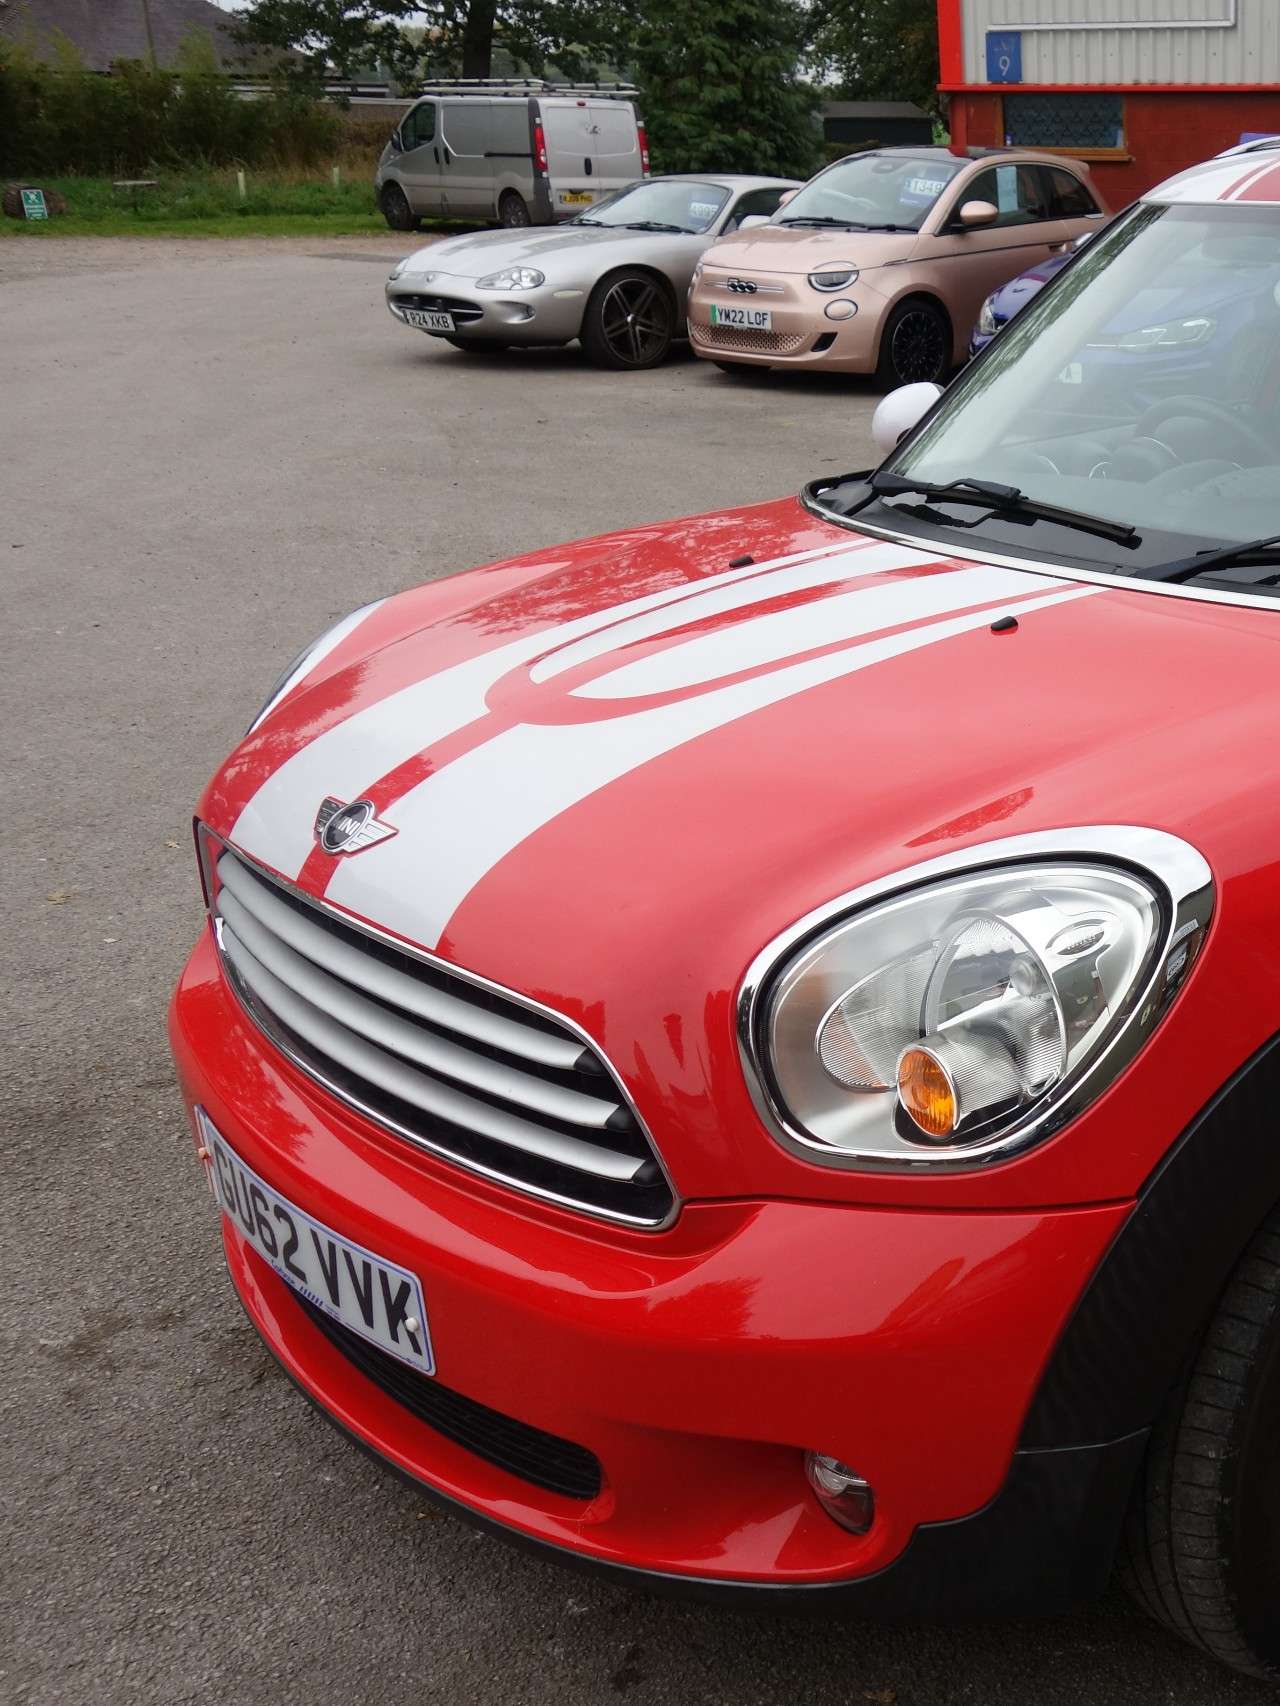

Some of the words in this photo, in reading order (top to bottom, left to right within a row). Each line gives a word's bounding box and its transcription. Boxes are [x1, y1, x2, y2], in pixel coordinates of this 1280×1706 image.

[428, 311, 450, 329] XKB
[717, 307, 745, 325] YM22
[213, 1139, 308, 1285] GU62
[309, 1227, 424, 1357] VVK
